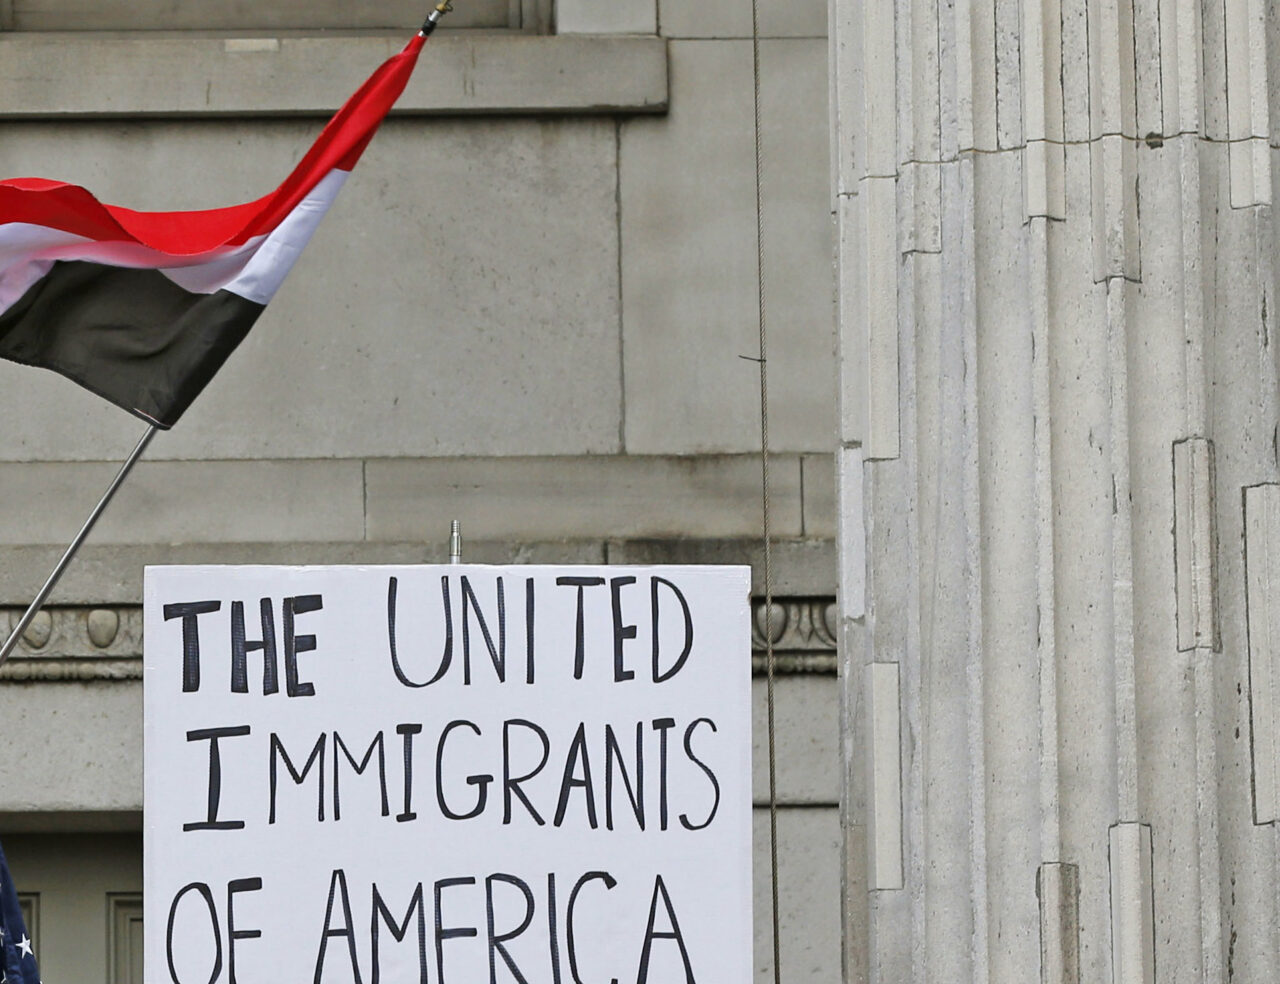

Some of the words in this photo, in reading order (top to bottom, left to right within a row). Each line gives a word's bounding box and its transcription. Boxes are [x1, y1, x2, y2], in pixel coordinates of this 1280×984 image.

[163, 594, 323, 697] THE
[387, 576, 694, 688] UNITED
[183, 718, 721, 831] IMMIGRANTS
